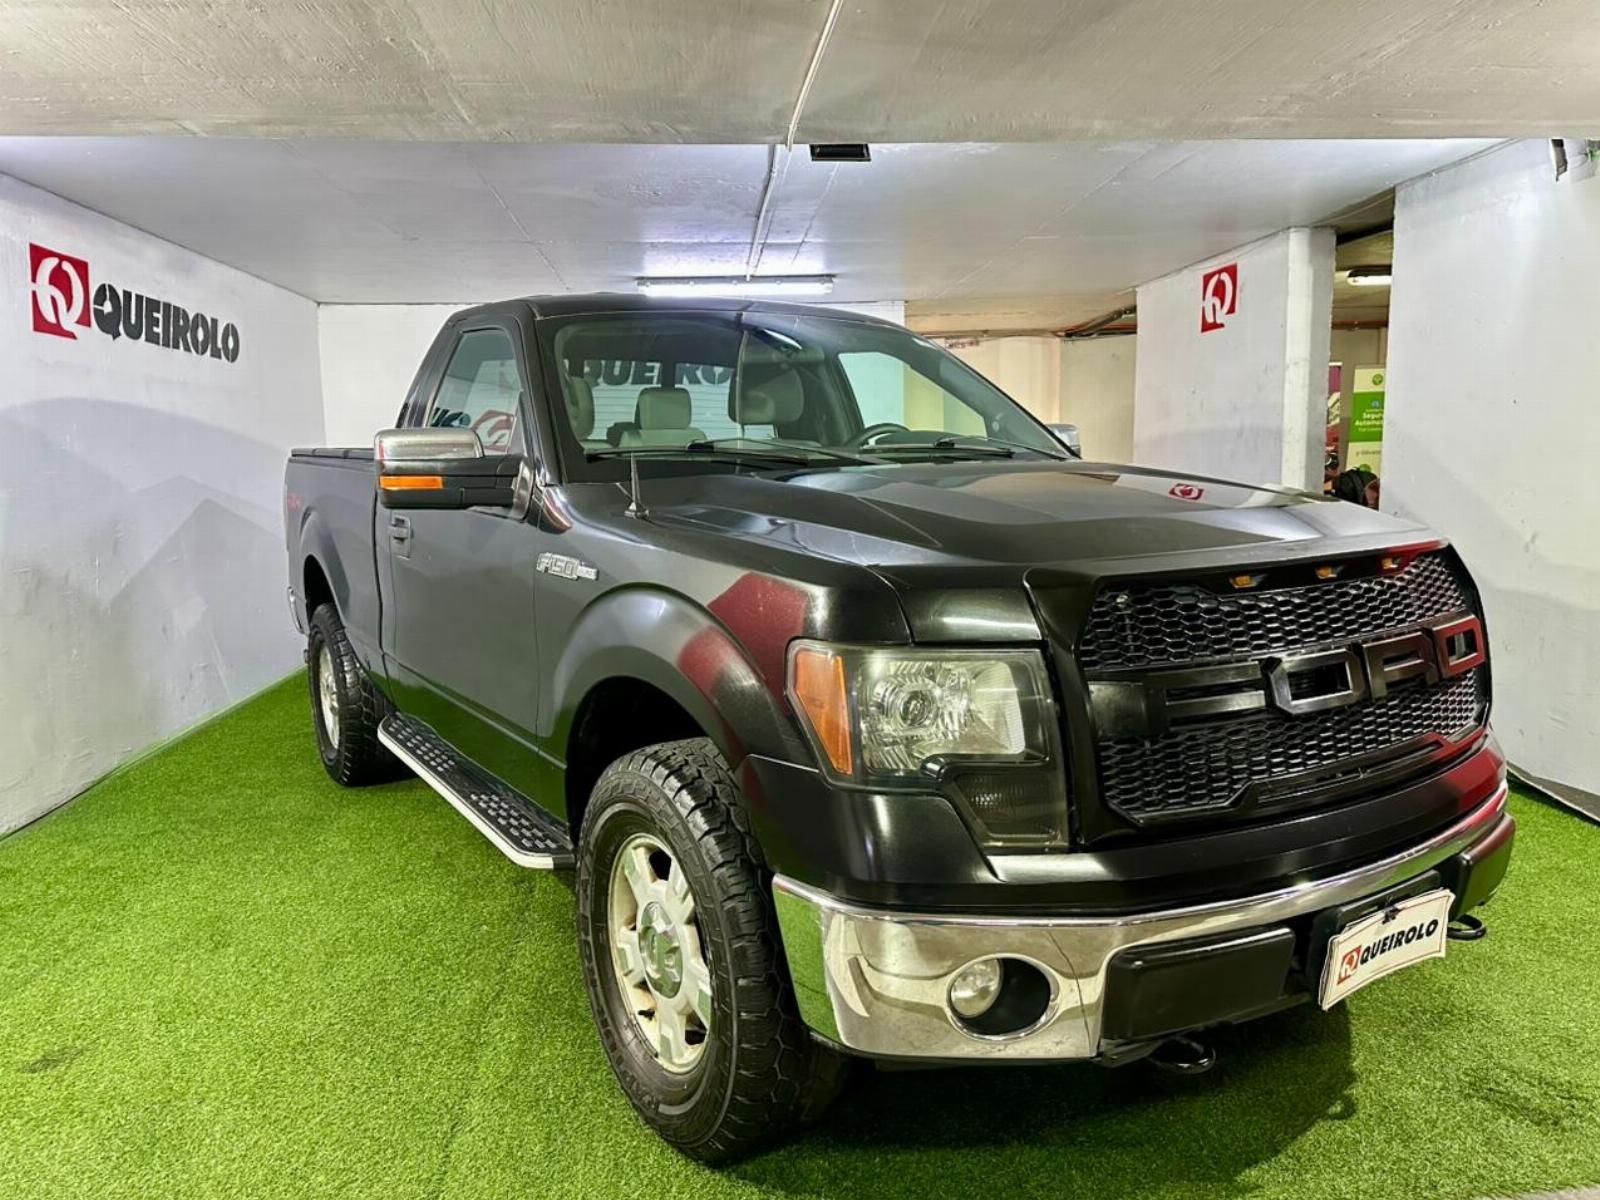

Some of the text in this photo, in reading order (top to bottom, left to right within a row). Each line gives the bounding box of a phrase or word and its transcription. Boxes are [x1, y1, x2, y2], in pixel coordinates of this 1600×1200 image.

[93, 283, 240, 363] QUEIROLO
[1146, 614, 1486, 736] FORD
[1359, 918, 1439, 966] QUEIROLO
